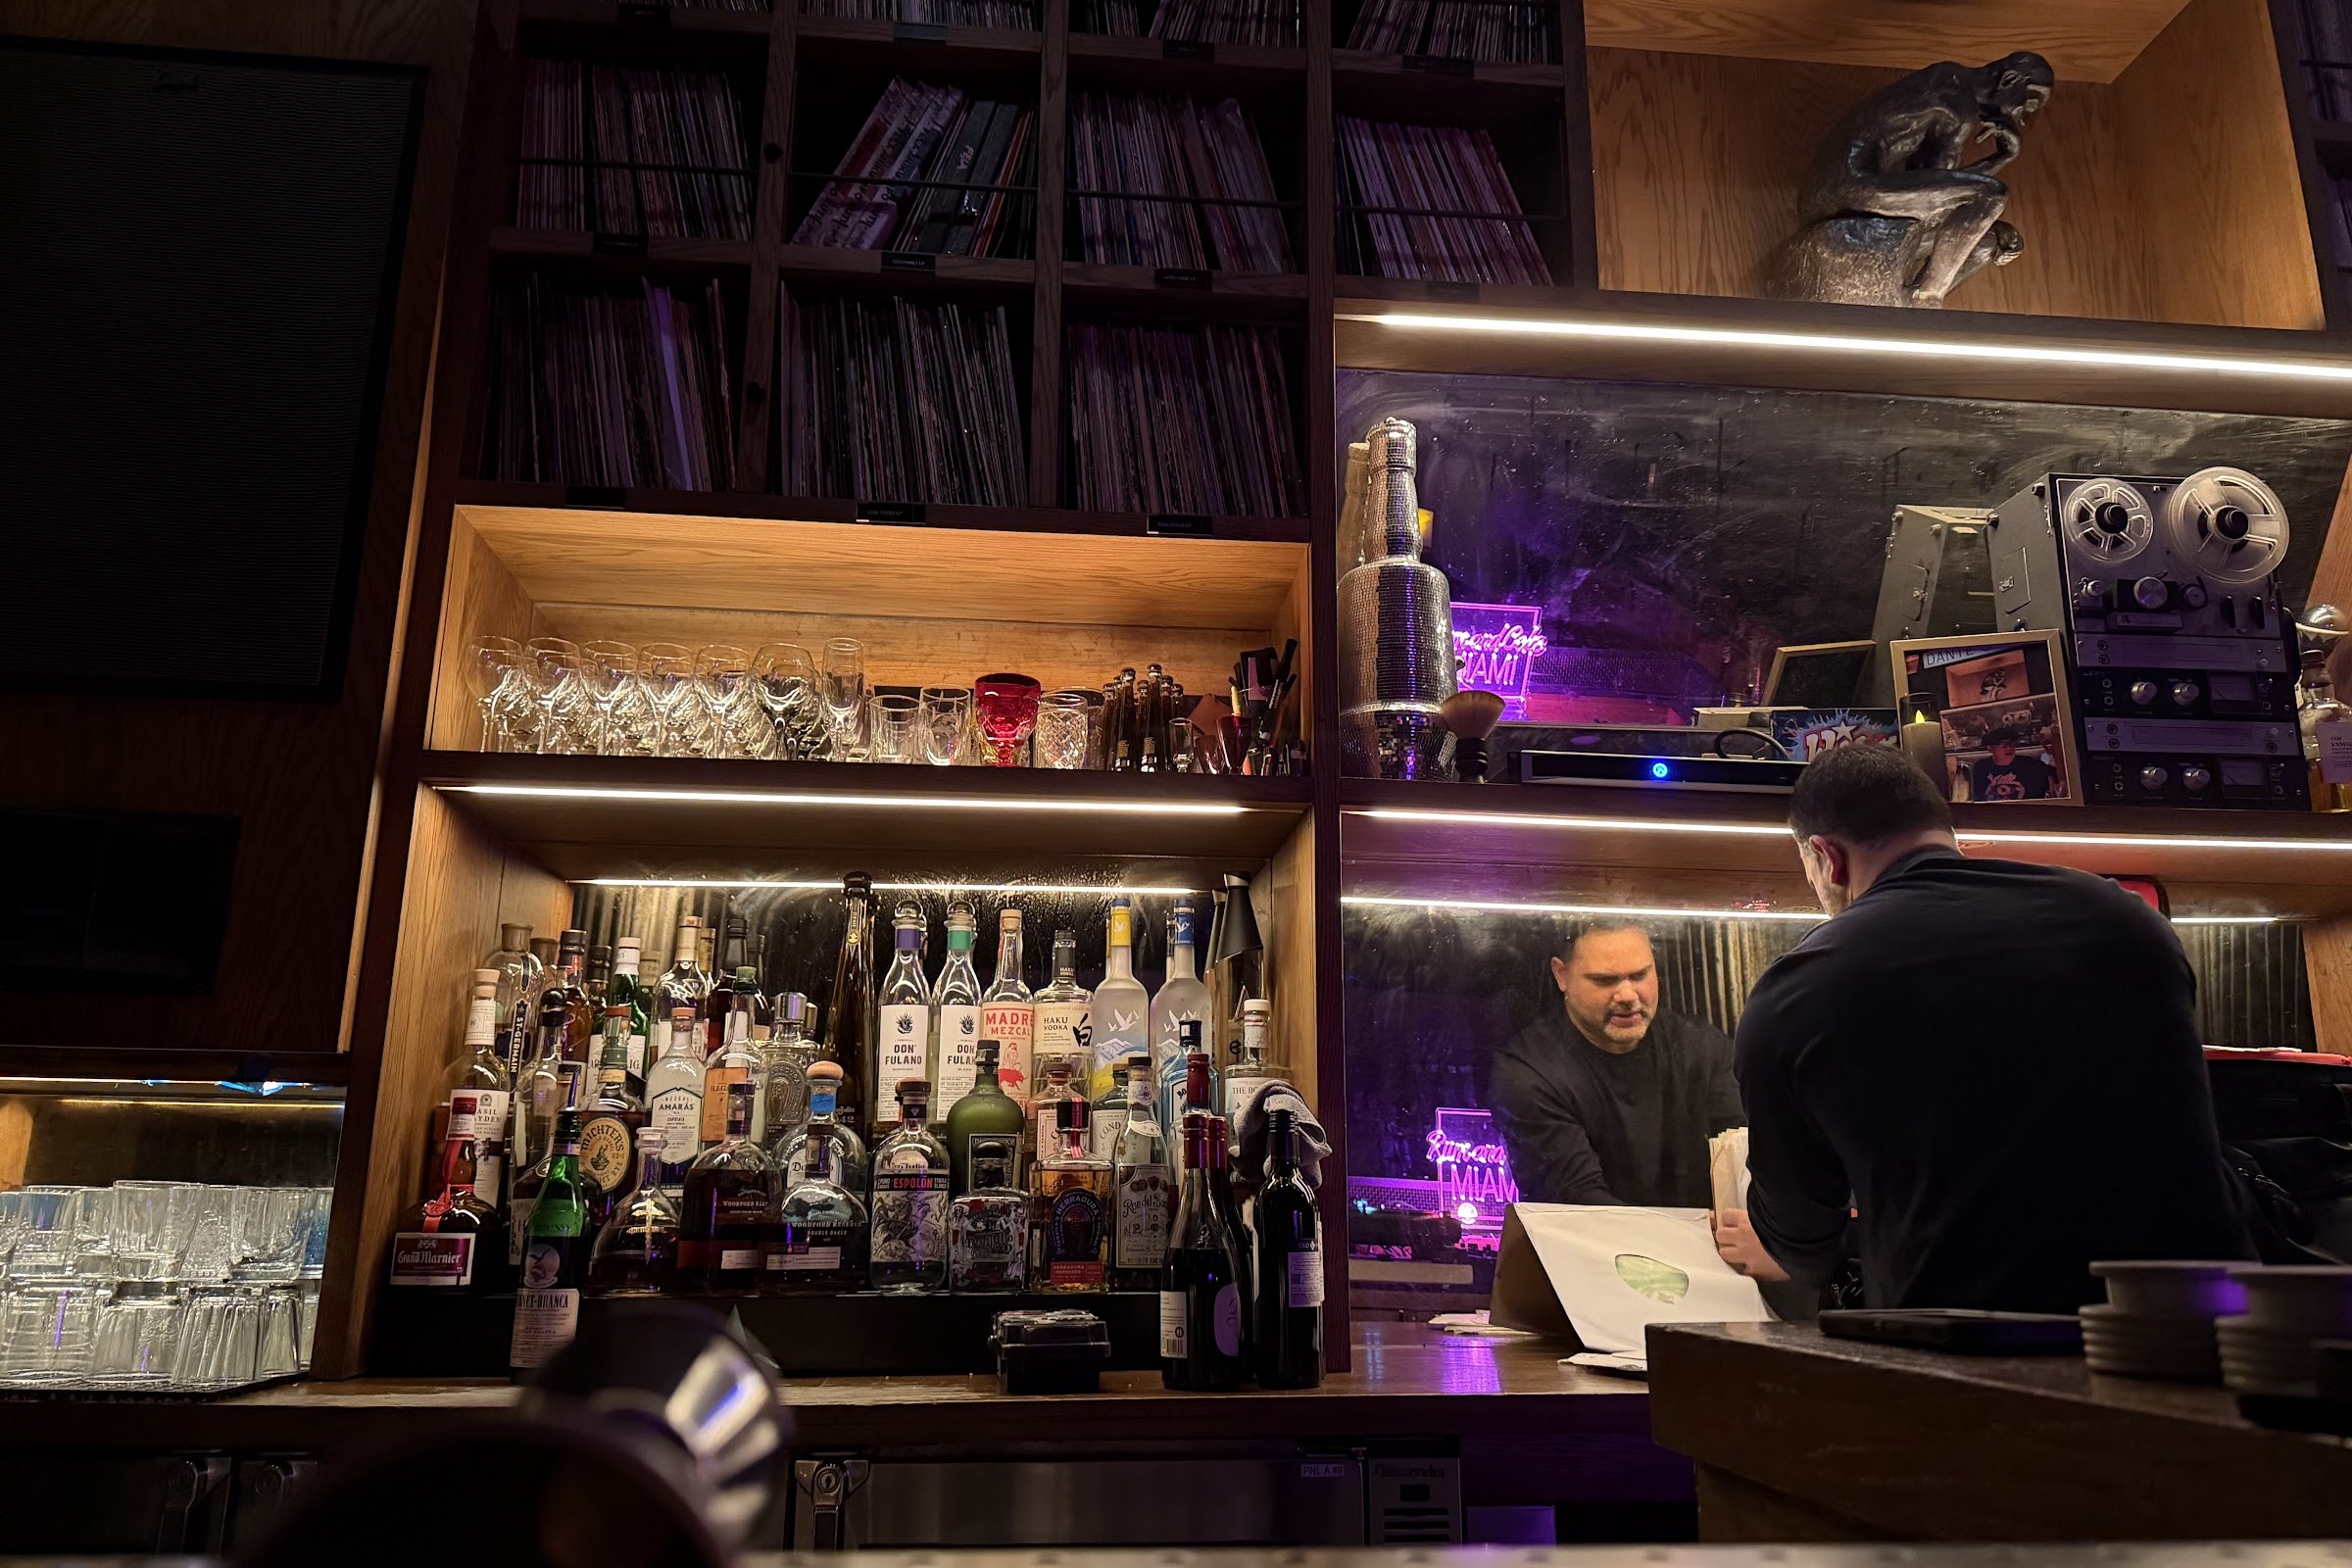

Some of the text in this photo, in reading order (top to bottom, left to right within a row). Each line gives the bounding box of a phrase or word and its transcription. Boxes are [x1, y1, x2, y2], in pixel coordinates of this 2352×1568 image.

[991, 1027, 1030, 1036] MEZCAL
[1072, 1012, 1093, 1048] 白
[510, 1016, 523, 1073] ST-GERMAIN
[894, 1044, 914, 1054] DON
[956, 1044, 975, 1054] DON
[885, 1055, 922, 1065] FULANO
[947, 1055, 977, 1065] FULAN
[659, 1102, 694, 1110] AMARÁS
[1100, 1121, 1121, 1140] COND
[1451, 1163, 1519, 1203] MIAM
[1055, 1195, 1100, 1215] HERRADURA
[418, 1250, 462, 1264] Marnier
